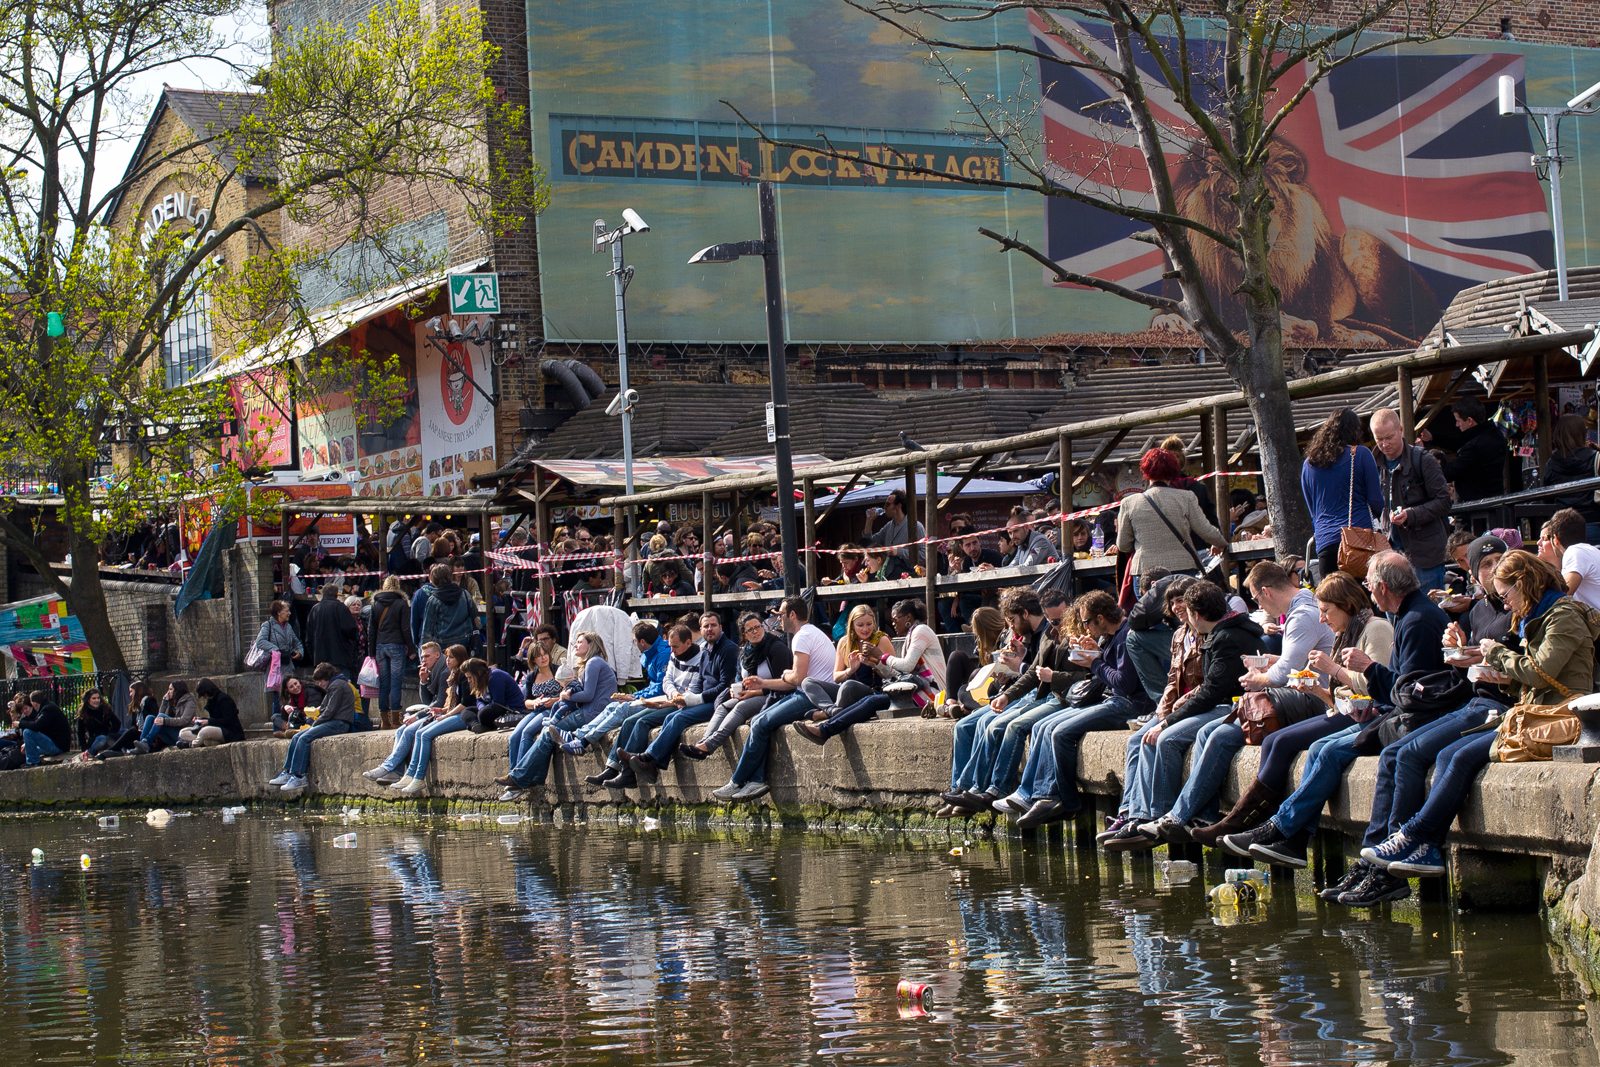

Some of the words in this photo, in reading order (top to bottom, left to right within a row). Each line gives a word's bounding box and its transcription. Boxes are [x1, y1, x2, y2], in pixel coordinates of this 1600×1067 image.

[568, 134, 738, 174] CAMDEN
[758, 142, 861, 182] LOCK
[865, 145, 1001, 185] VILLAGE
[331, 414, 354, 433] FOOD
[428, 419, 453, 444] JAPANESE
[319, 537, 336, 545] VERY
[337, 536, 351, 544] DAY
